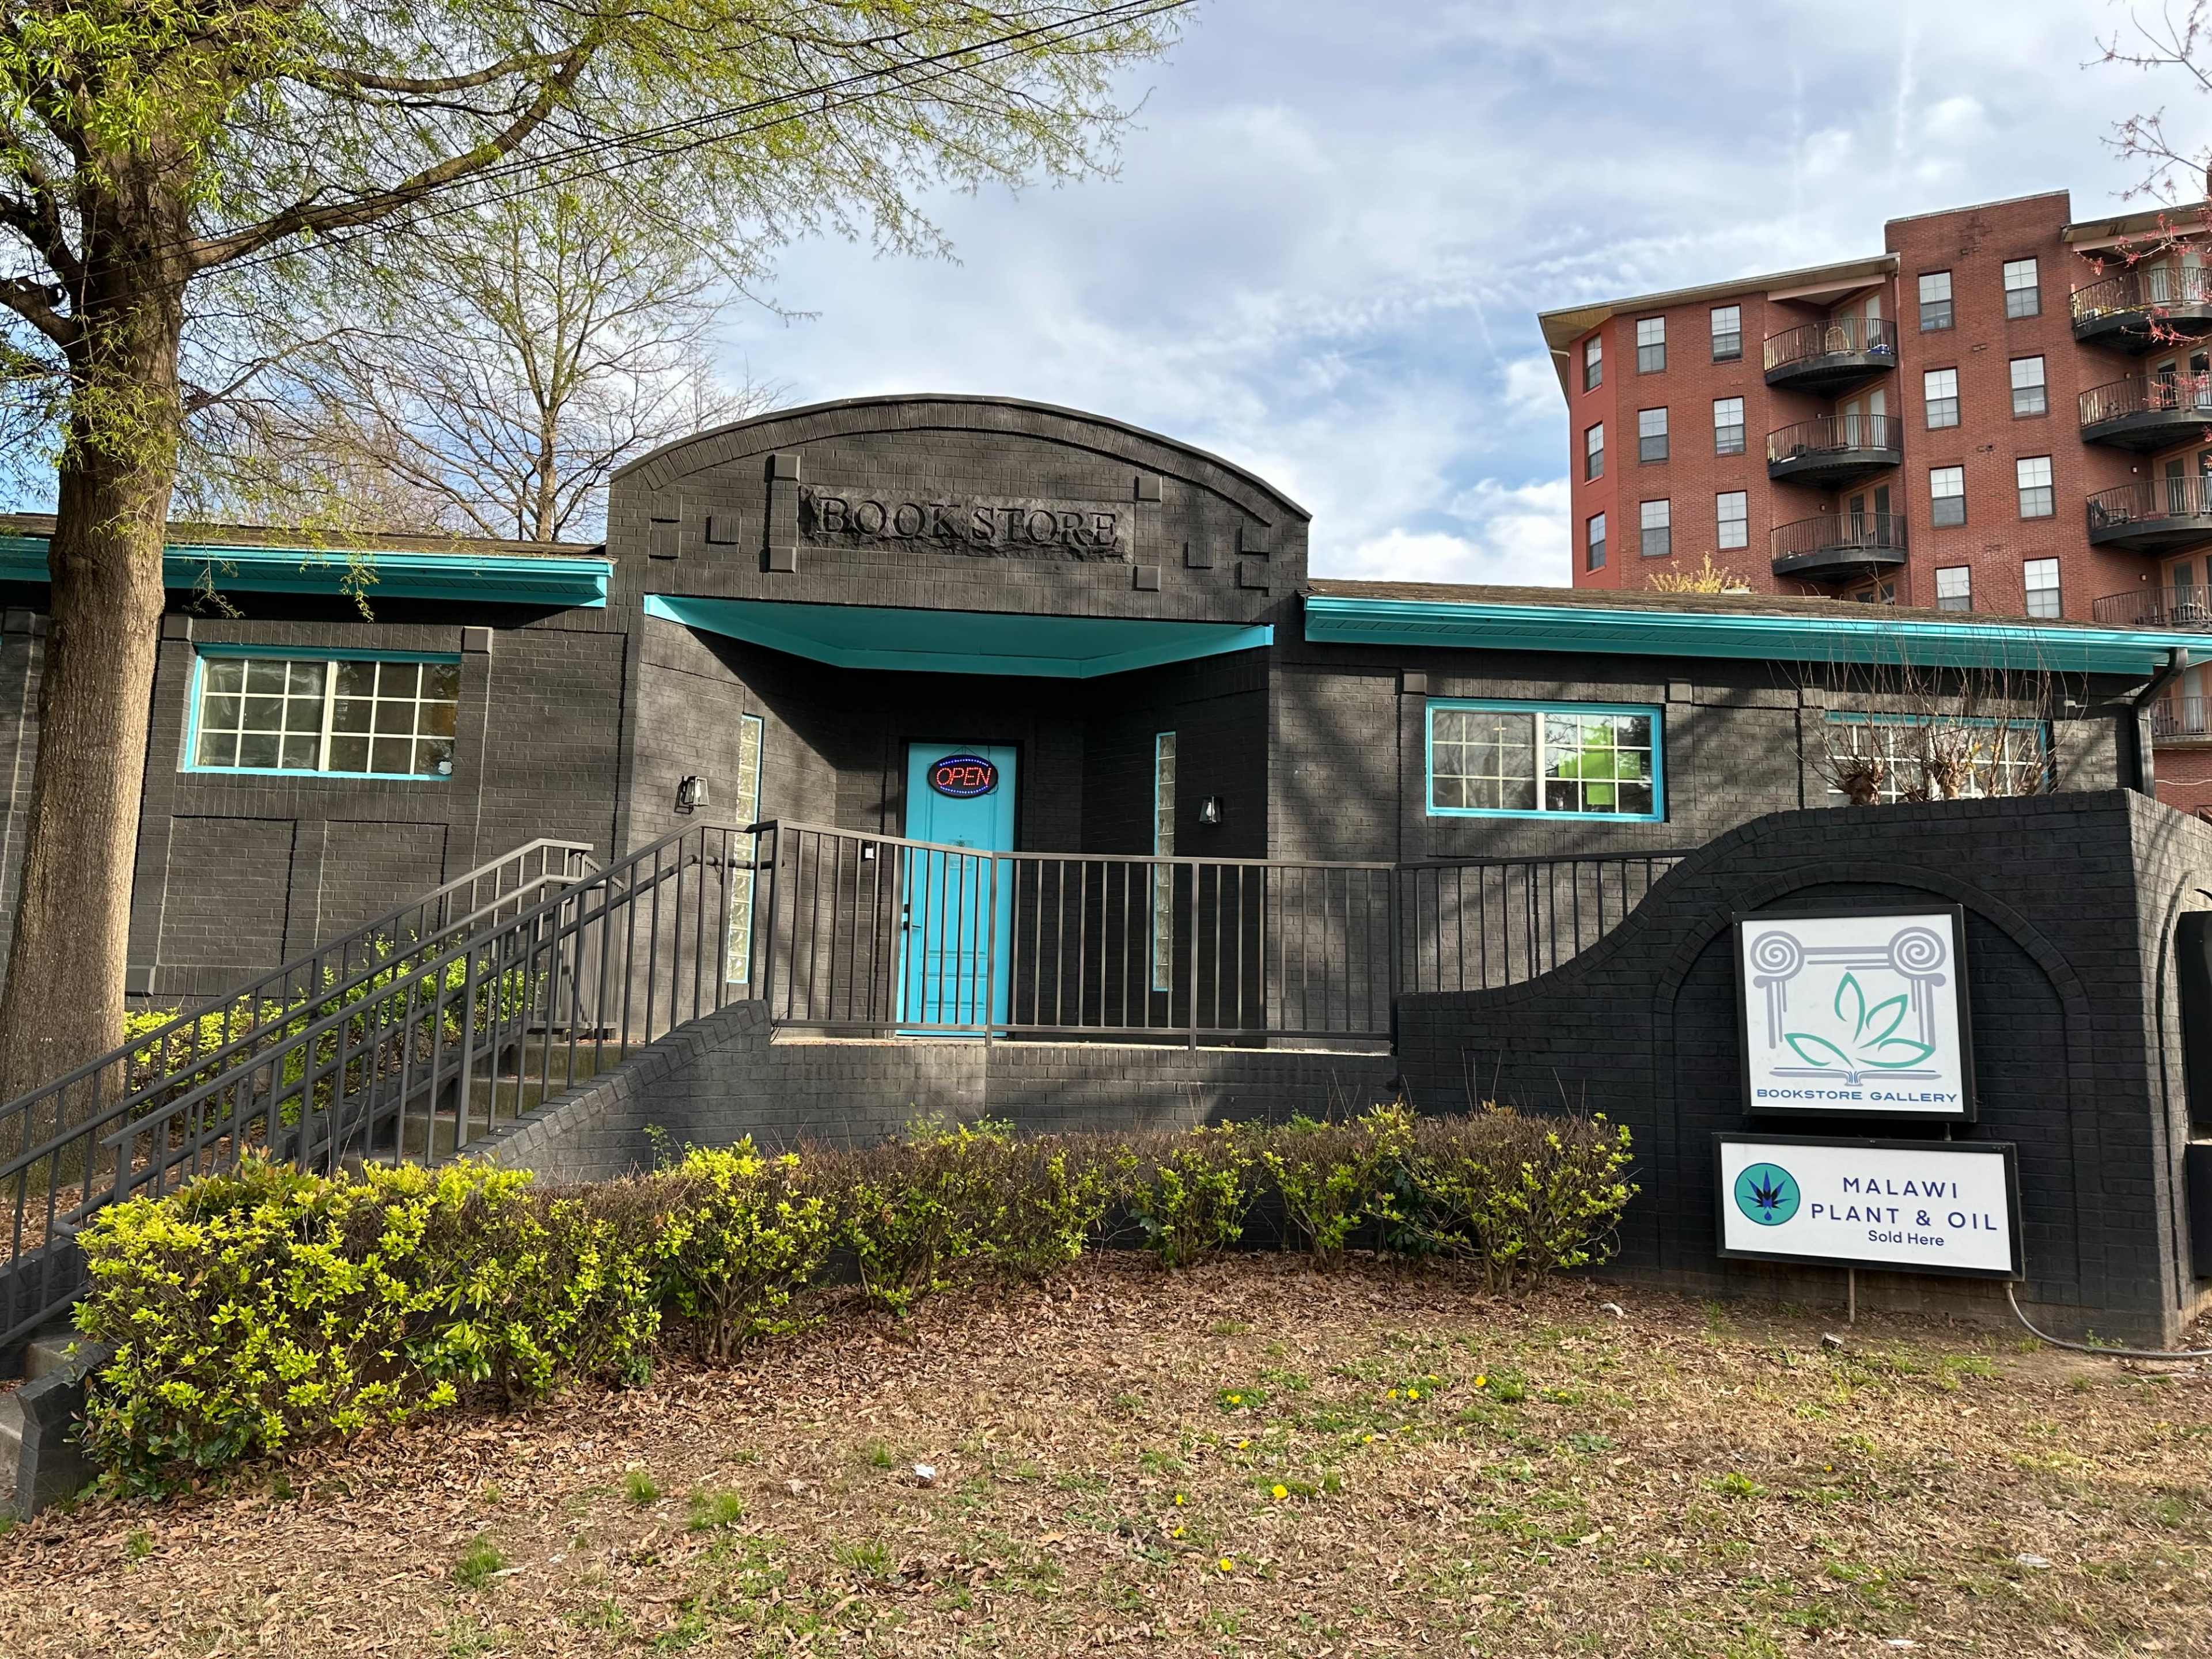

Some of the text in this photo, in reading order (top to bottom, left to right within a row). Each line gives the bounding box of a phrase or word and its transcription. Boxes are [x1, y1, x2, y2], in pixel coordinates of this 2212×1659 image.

[936, 767, 991, 786] OPEN
[1757, 1089, 1957, 1103] BOOKSTORE GALLERY
[1843, 1177, 1957, 1198] MALAWI
[1811, 1203, 1997, 1231] PLANT & OIL
[1868, 1230, 1945, 1247] Sold Here
